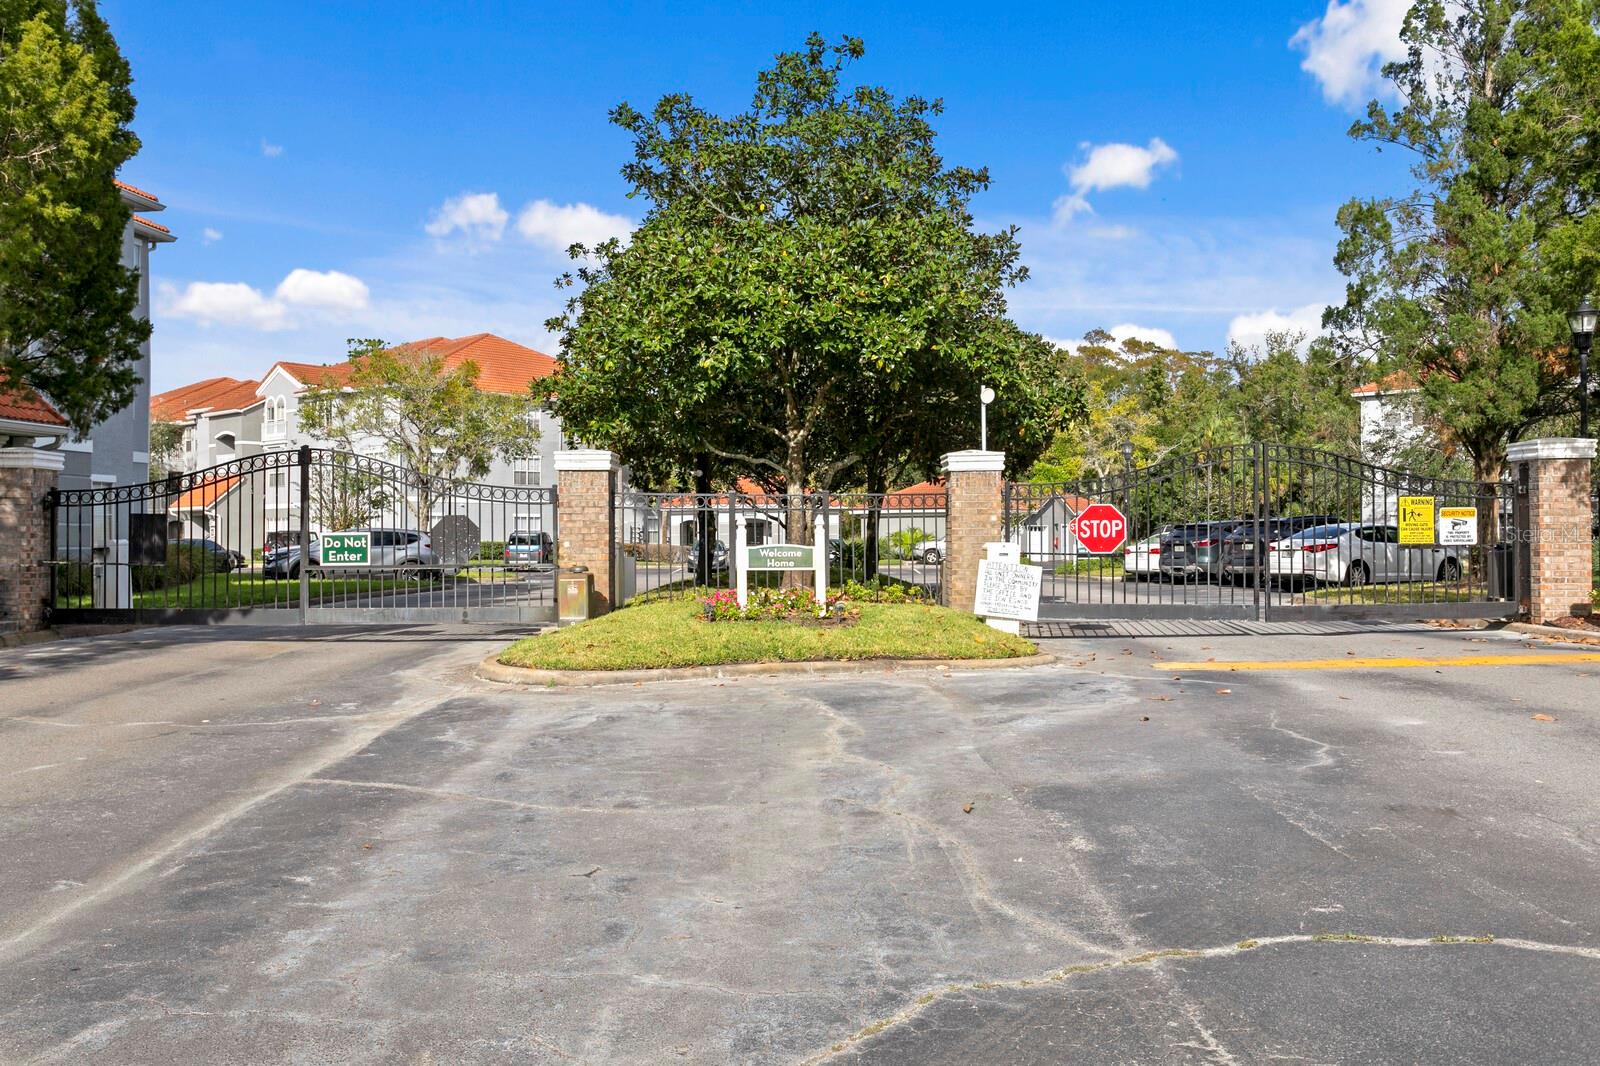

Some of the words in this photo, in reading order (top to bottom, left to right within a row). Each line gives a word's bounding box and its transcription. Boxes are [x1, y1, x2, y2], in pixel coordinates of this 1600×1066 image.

[1080, 519, 1123, 539] STOP
[324, 537, 341, 548] Do
[344, 537, 367, 548] Not
[328, 551, 363, 562] Enter
[760, 548, 802, 557] Welcome
[767, 559, 794, 567] Home
[986, 561, 1029, 573] ATTENTION
[1012, 572, 1034, 581] OWNERS
[1008, 578, 1039, 588] COMMUNITY
[995, 589, 1017, 597] OFFICE
[1020, 592, 1032, 600] AND
